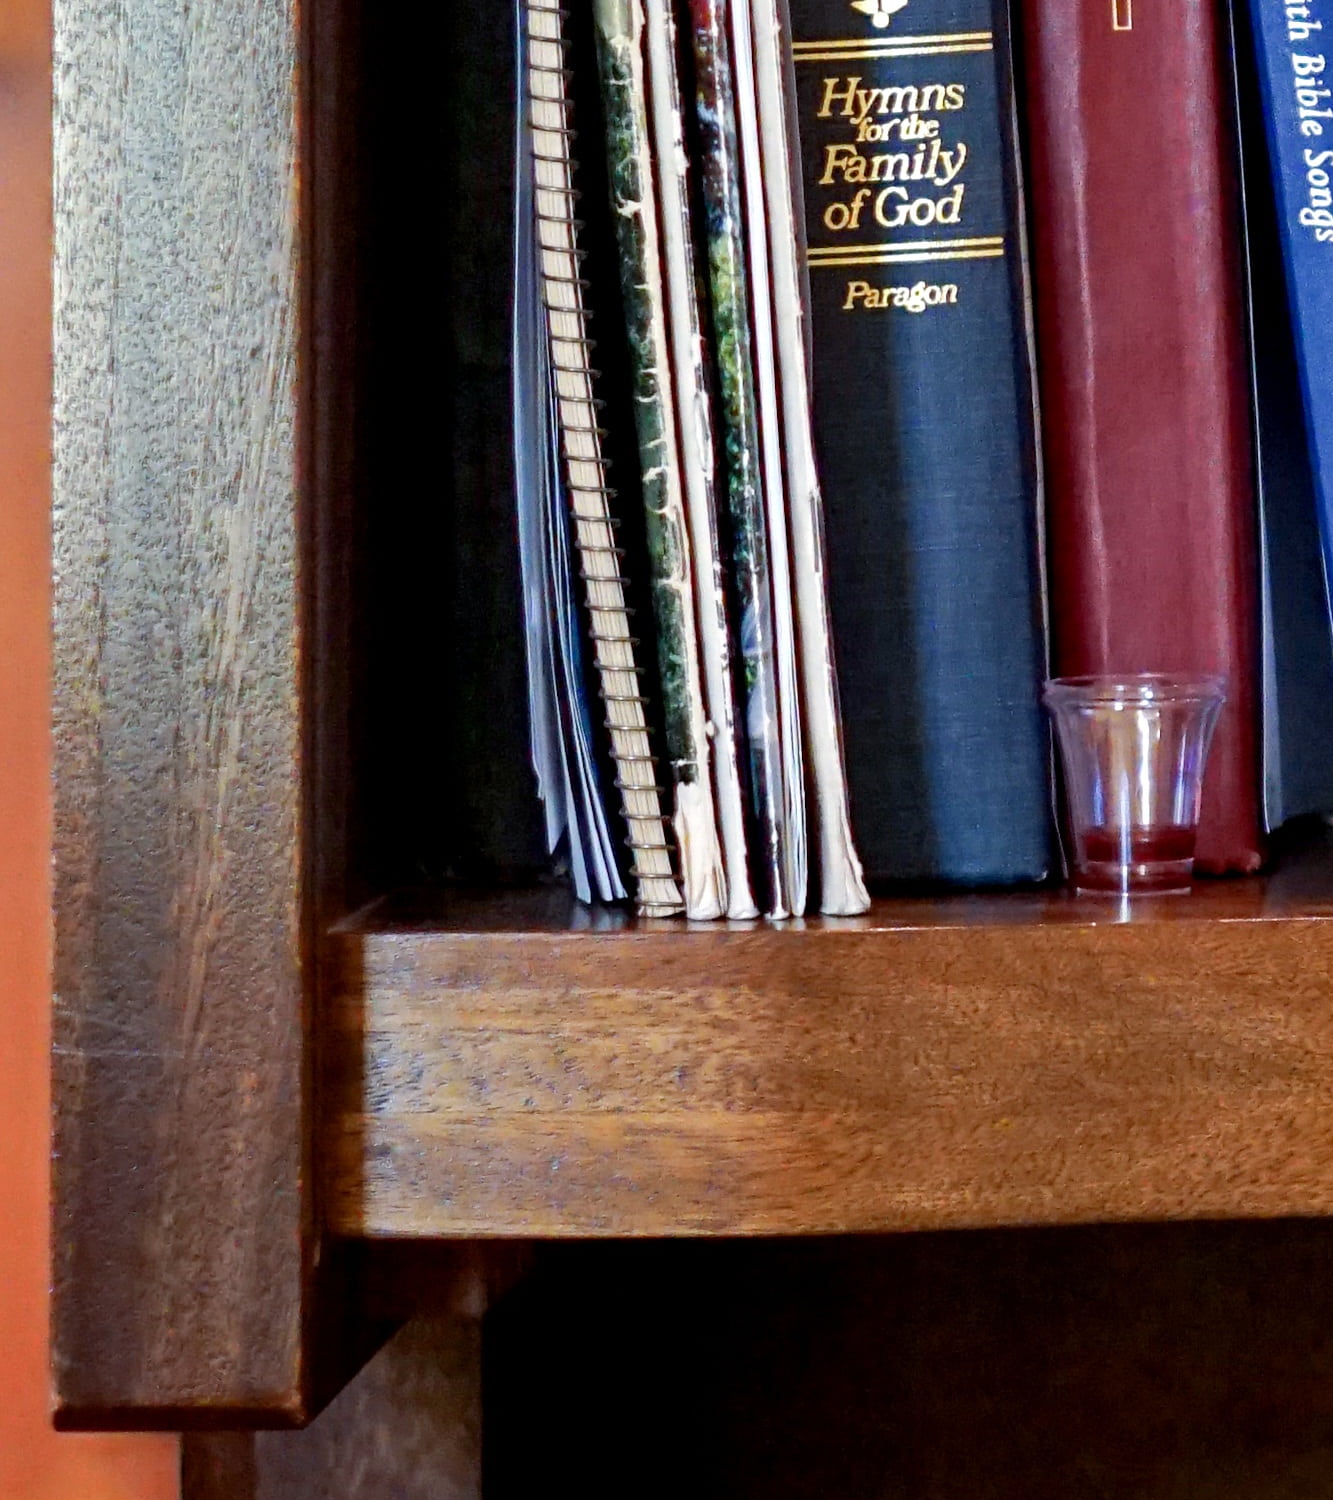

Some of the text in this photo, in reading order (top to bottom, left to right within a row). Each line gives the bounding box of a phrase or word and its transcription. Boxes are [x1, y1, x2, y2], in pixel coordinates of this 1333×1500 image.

[817, 76, 966, 124] Hymns
[856, 113, 940, 142] for the
[819, 138, 967, 187] Family
[823, 183, 965, 231] of God
[842, 280, 959, 313] Paragon
